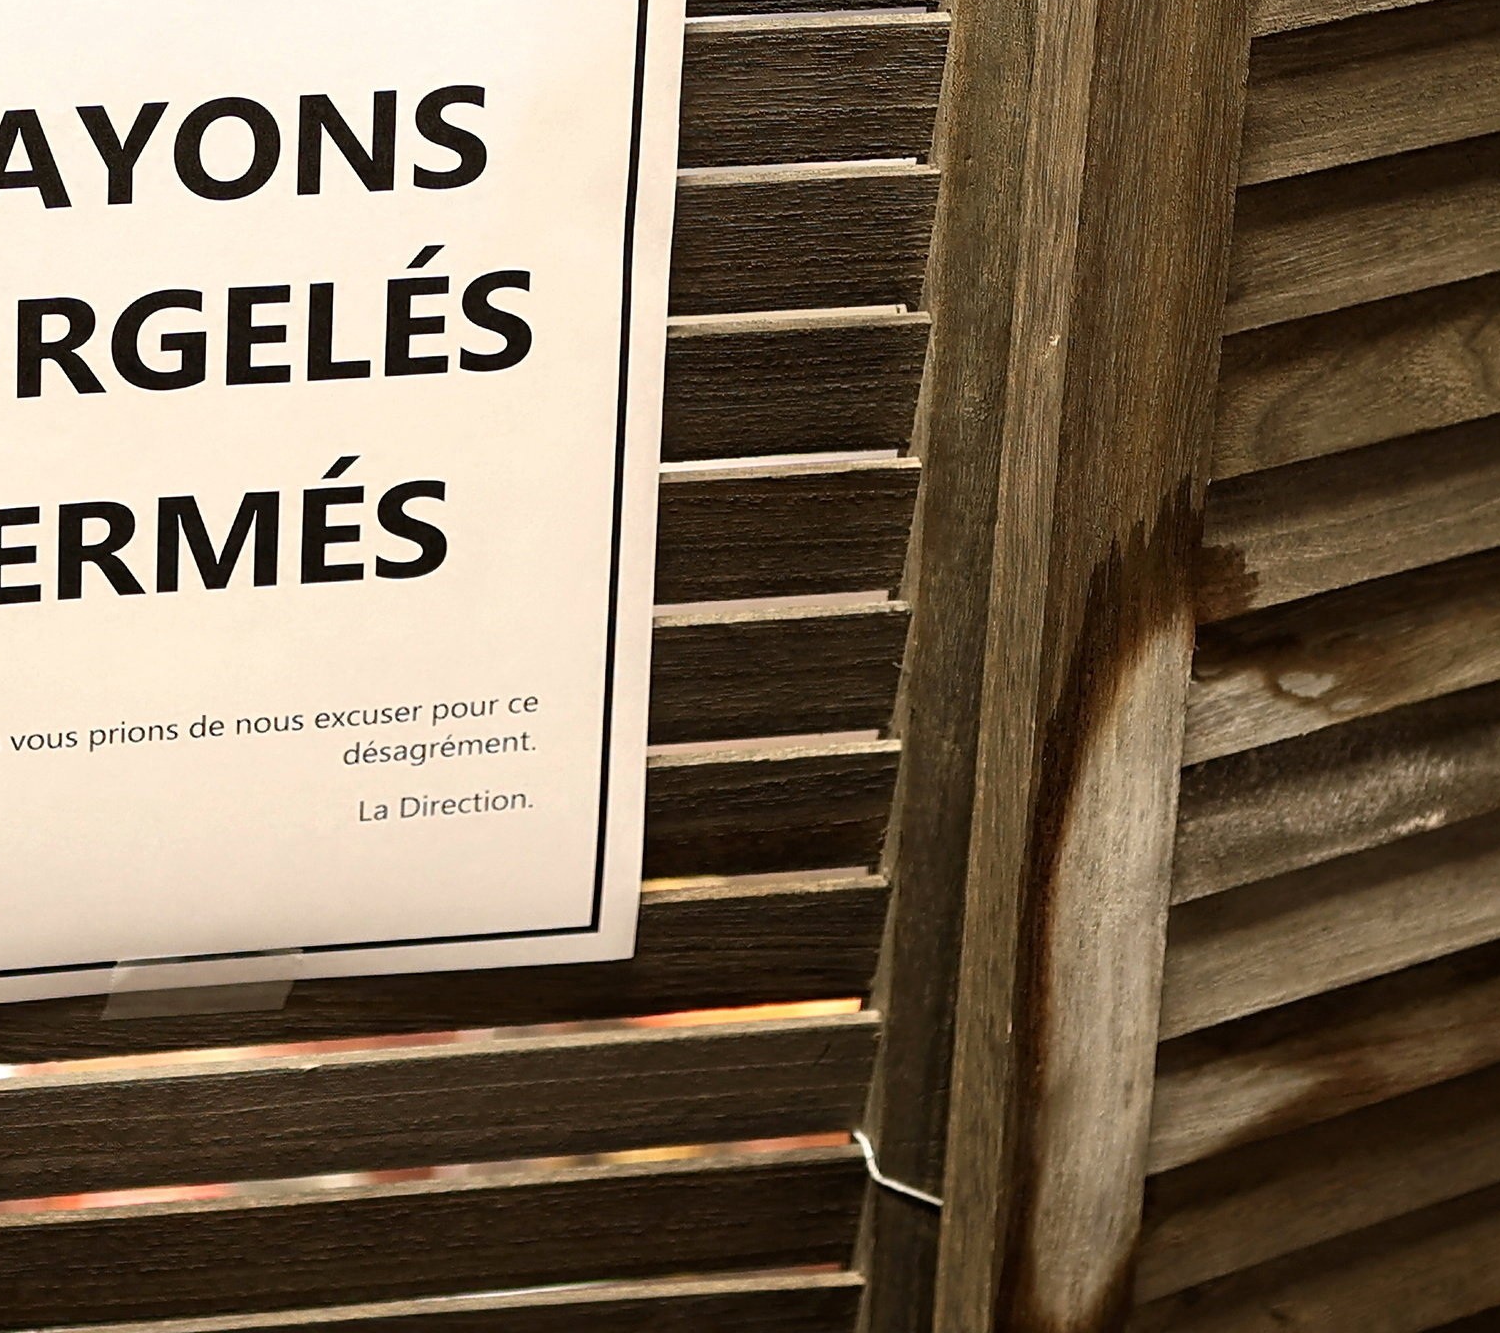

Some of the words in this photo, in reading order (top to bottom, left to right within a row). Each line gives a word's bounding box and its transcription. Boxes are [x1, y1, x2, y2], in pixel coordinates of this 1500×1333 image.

[9, 730, 79, 752] vous
[89, 721, 180, 753] prions
[188, 714, 226, 739] de
[236, 713, 305, 736] nous
[314, 704, 424, 730] excuser
[432, 698, 500, 727] pour
[507, 695, 539, 715] ce
[342, 731, 538, 767] désagrément.
[358, 800, 389, 823] La
[399, 789, 534, 820] Direction.
